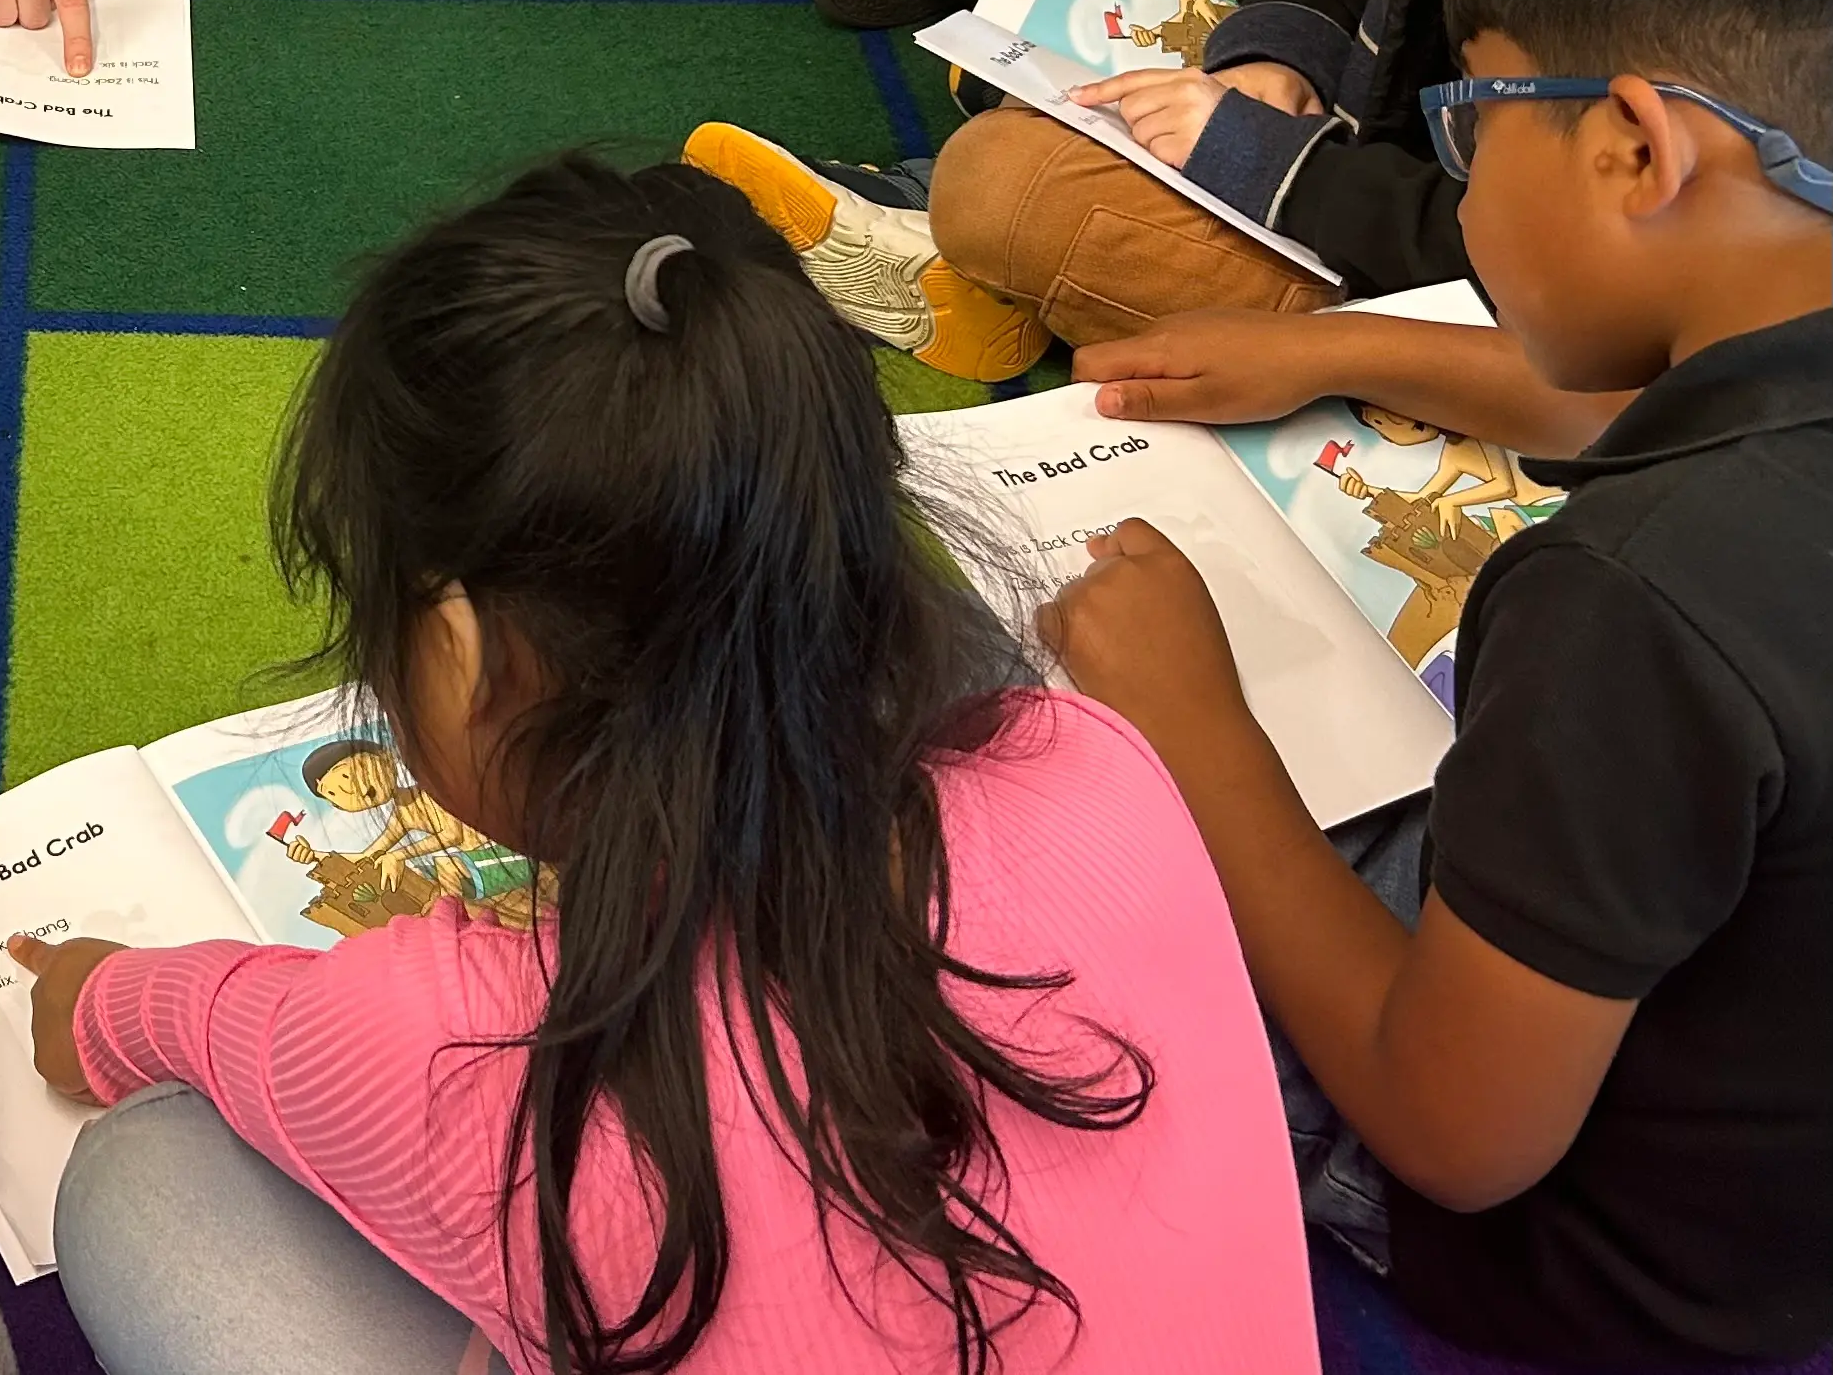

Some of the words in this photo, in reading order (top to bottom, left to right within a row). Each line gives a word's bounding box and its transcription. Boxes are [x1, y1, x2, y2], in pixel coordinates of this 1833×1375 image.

[94, 77, 123, 85] Zack
[137, 77, 160, 85] This
[43, 104, 76, 116] Bad
[82, 107, 114, 118] The
[991, 468, 1038, 487] The
[1037, 452, 1088, 478] Bad
[1089, 435, 1150, 462] Crab
[1019, 543, 1032, 554] is
[1029, 534, 1073, 552] Zack
[1071, 522, 1123, 544] Chan
[46, 821, 104, 857] Crab
[14, 918, 72, 941] hang.
